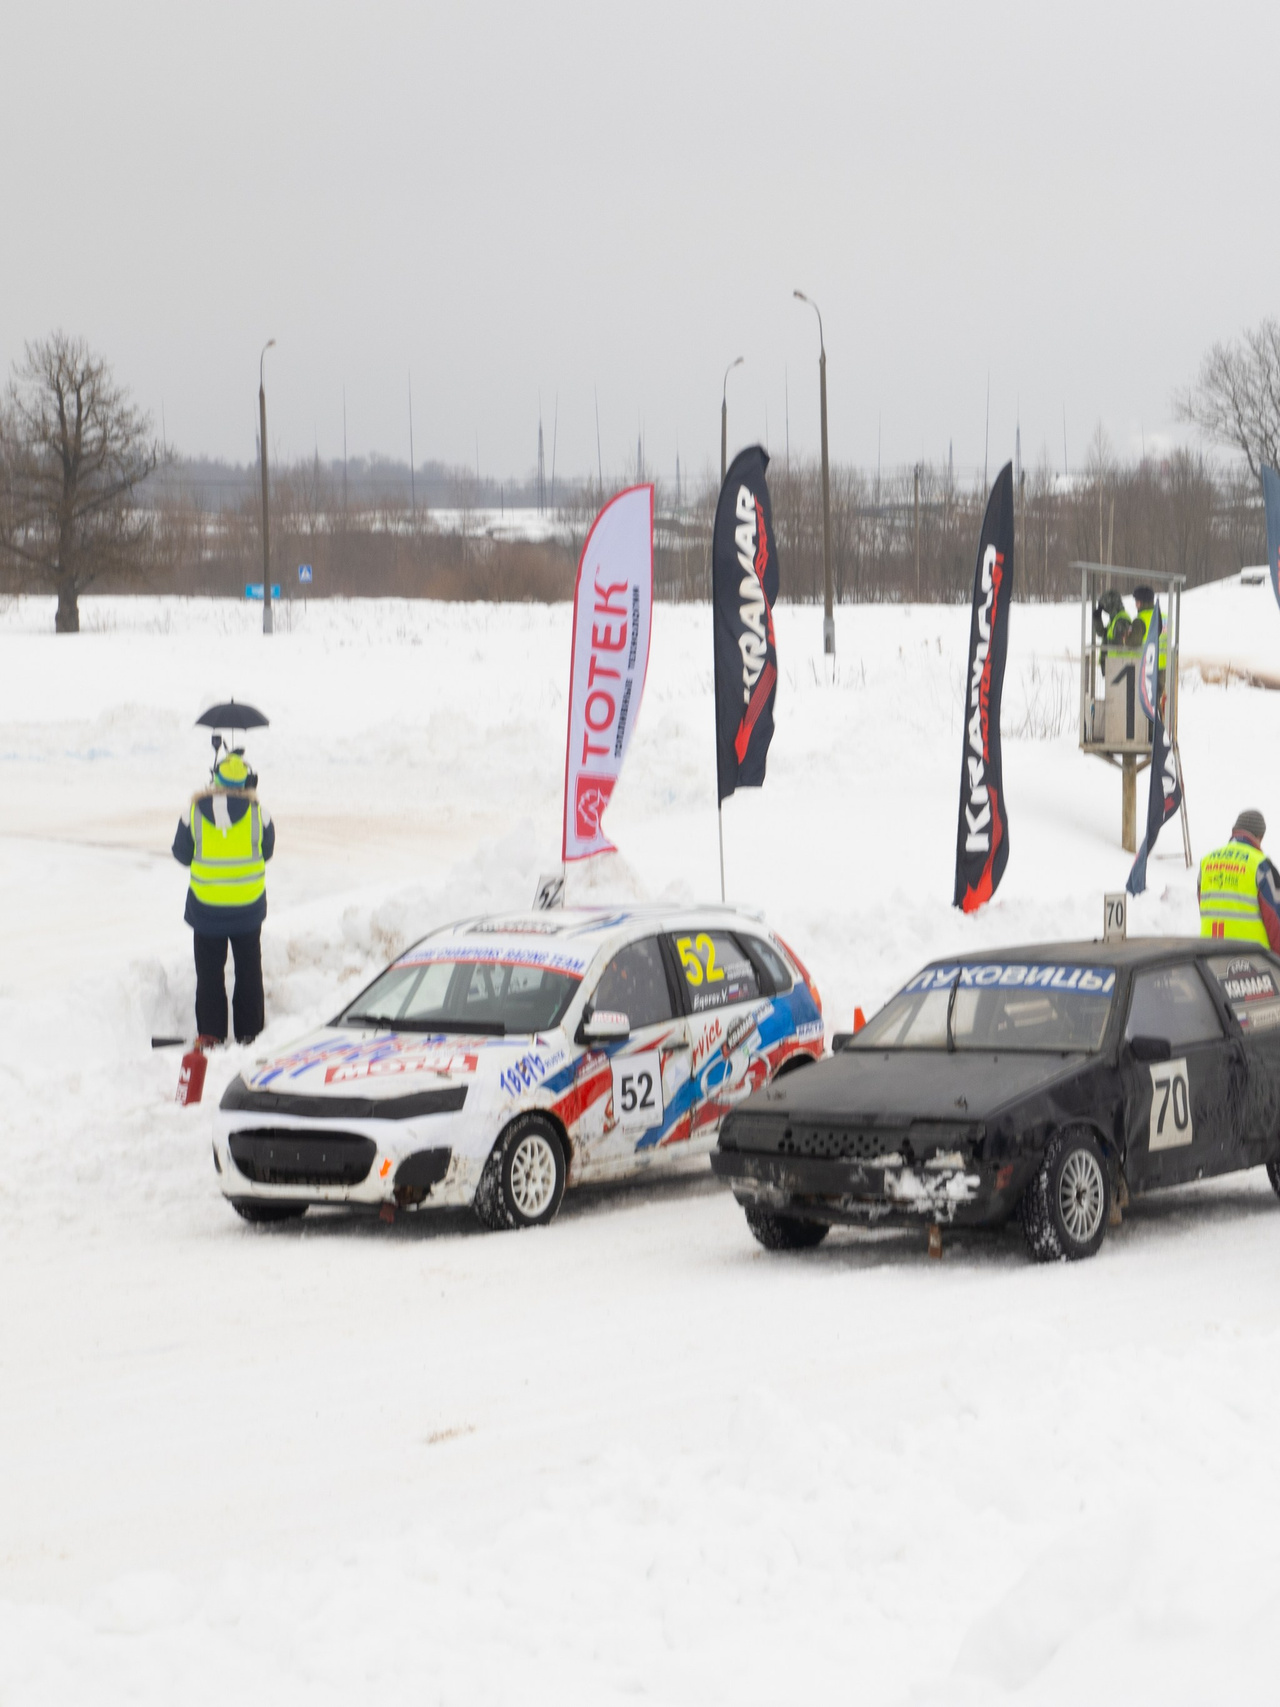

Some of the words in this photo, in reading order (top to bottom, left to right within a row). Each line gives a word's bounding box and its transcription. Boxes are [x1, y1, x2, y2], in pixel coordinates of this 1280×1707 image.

[1111, 664, 1135, 740] 1
[539, 878, 564, 910] 52
[1106, 901, 1124, 930] 70
[677, 932, 725, 987] 52
[906, 965, 1116, 993] ЛУХОВИЦЫ
[1225, 974, 1273, 999] KRAMAR
[332, 1055, 471, 1084] MOTUL
[620, 1072, 656, 1112] 52
[1154, 1075, 1189, 1137] 70
